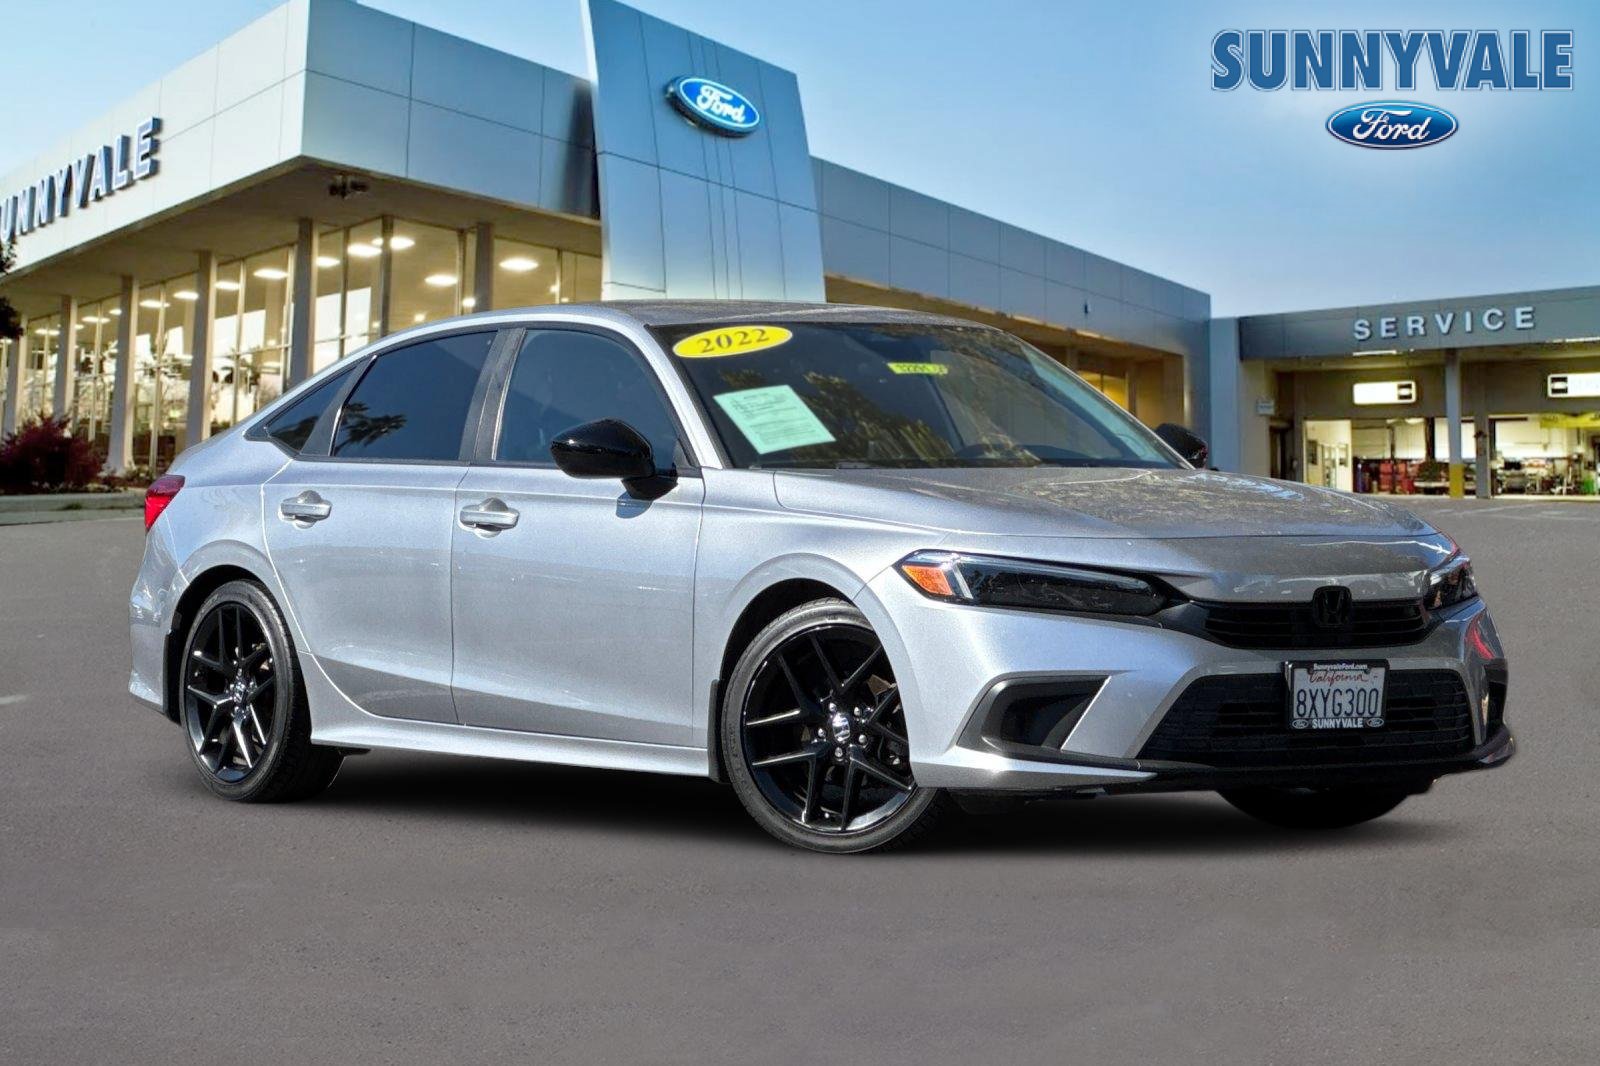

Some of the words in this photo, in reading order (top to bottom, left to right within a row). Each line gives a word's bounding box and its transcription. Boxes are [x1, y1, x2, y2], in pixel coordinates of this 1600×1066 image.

[697, 85, 745, 122] Ford
[0, 117, 161, 243] UNNYVALE
[1353, 306, 1535, 341] SERVICE
[697, 328, 769, 353] 2022
[1309, 669, 1369, 686] California
[1297, 688, 1379, 717] 8XYG300
[1312, 718, 1364, 729] SUNNYVALE
